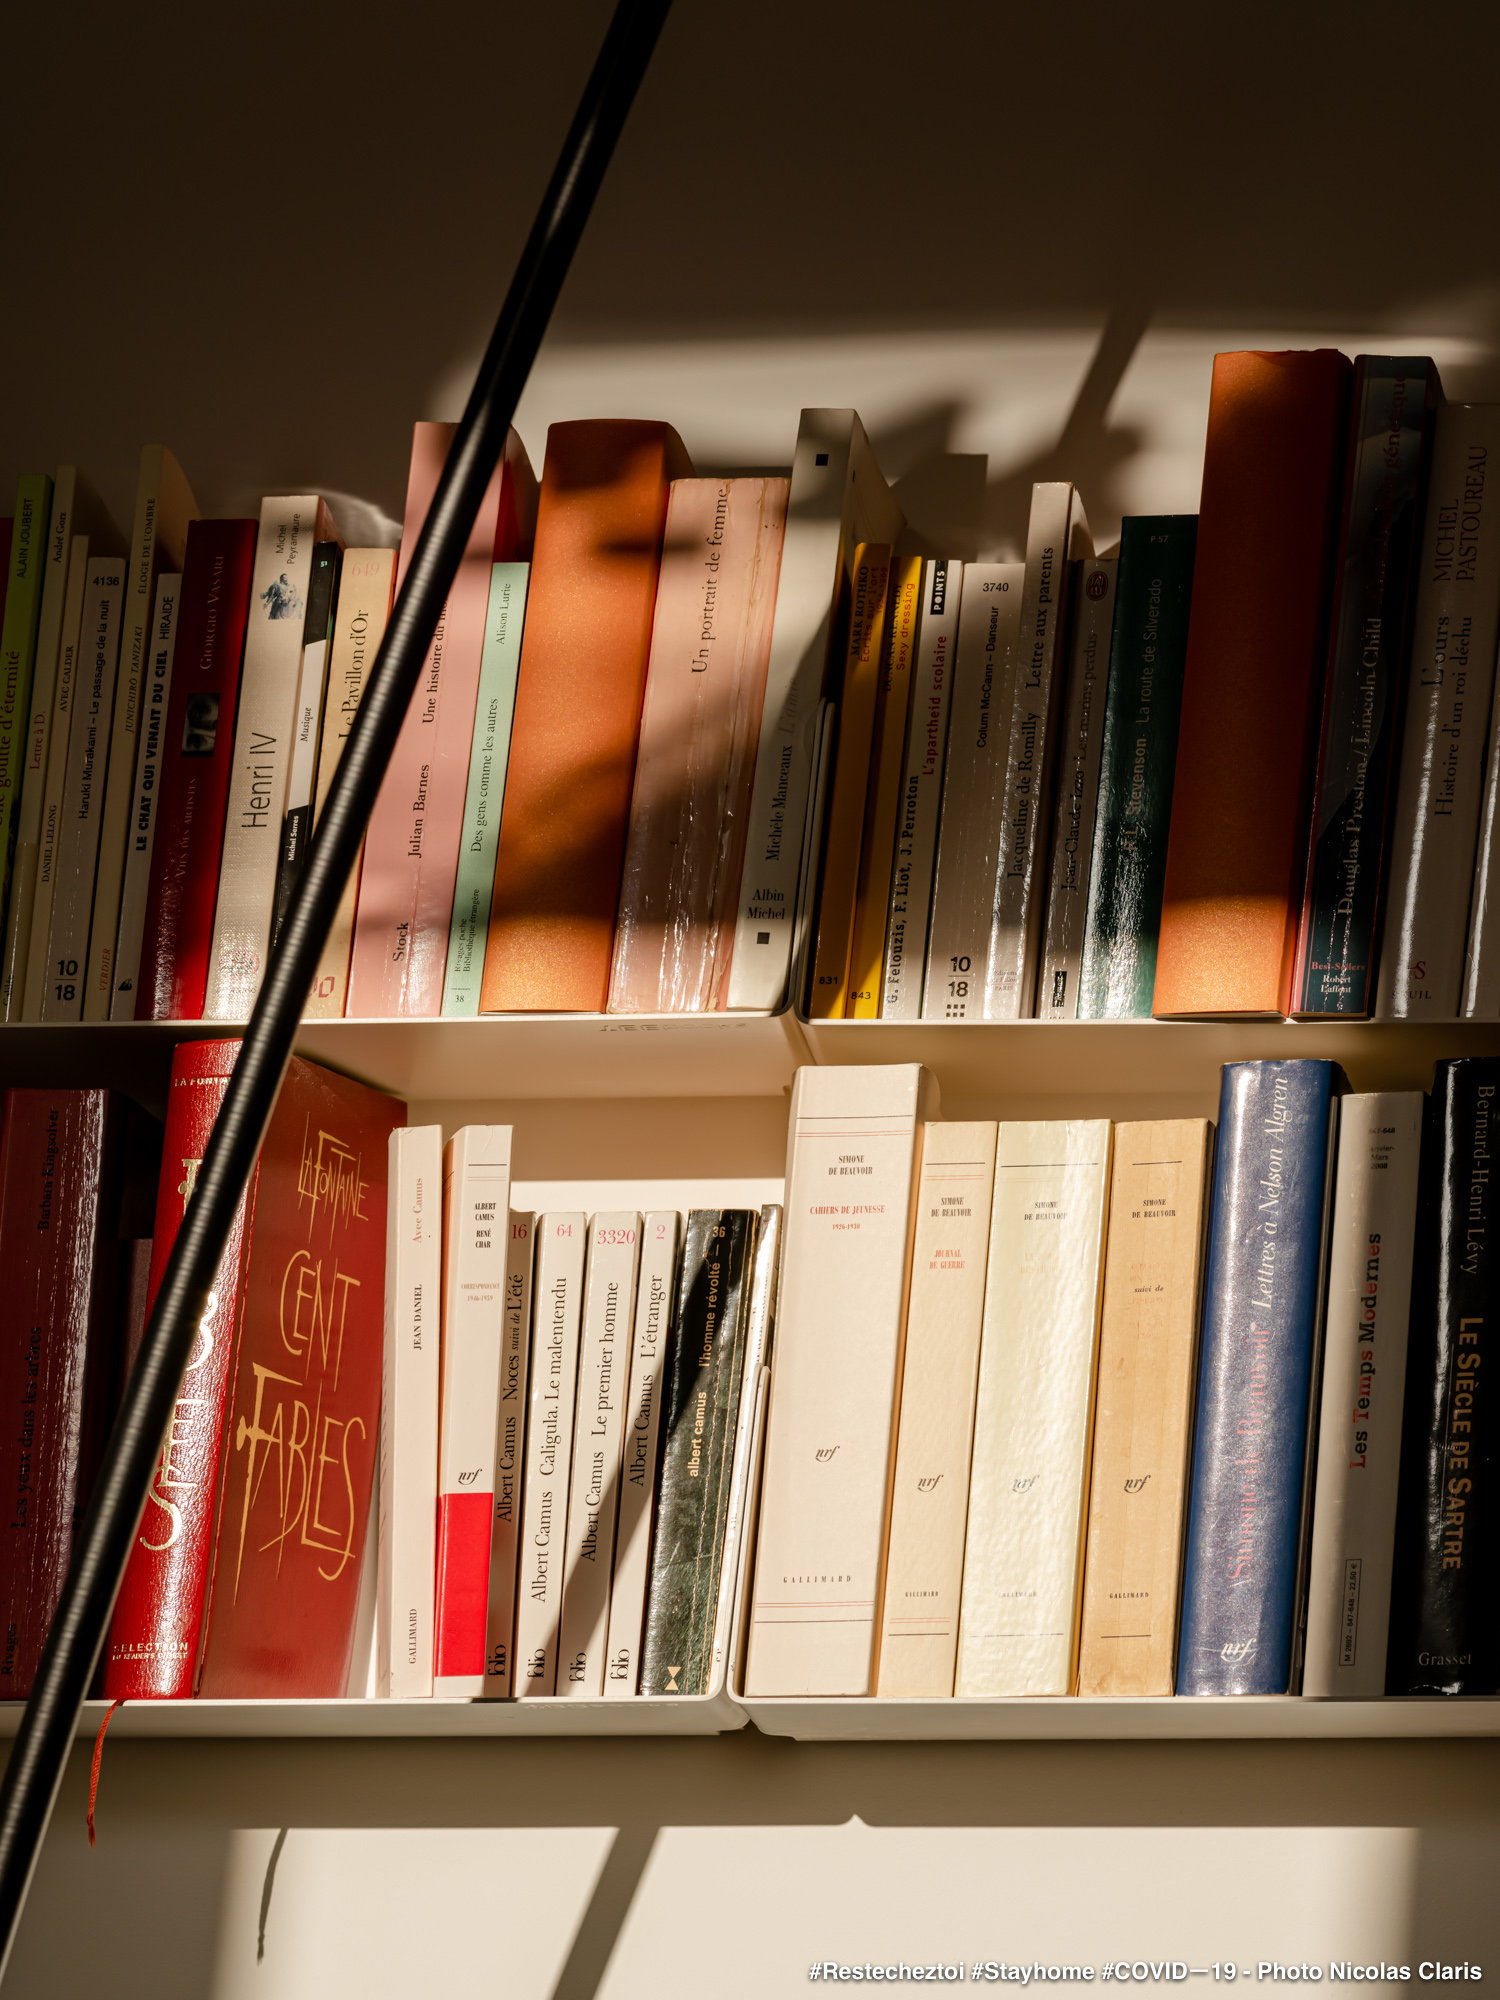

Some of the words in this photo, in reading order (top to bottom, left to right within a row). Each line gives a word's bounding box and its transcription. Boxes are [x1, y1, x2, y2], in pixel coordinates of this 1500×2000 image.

[21, 498, 34, 545] JOUBERT
[56, 512, 66, 534] Gorz
[707, 489, 728, 546] femme
[1456, 446, 1488, 581] PASTOUREAU
[53, 536, 64, 563] André
[276, 524, 287, 554] Michel
[287, 513, 300, 564] Peyramaure
[1433, 499, 1459, 582] MICHEL
[17, 546, 30, 579] ALAIN
[351, 561, 380, 576] 649
[705, 552, 720, 573] de
[1039, 547, 1053, 603] parents
[93, 576, 120, 586] 4136
[499, 583, 511, 609] Lurie
[855, 566, 868, 617] ROTHKO
[933, 571, 945, 610] POINTS
[983, 582, 1009, 592] 3740
[98, 616, 107, 633] la
[100, 600, 110, 614] nuit
[160, 596, 174, 640] HIRAIDE
[702, 579, 718, 641] portrait
[901, 583, 915, 637] dressing
[1035, 608, 1047, 637] aux
[97, 634, 106, 649] de
[434, 625, 444, 641] du
[496, 613, 507, 645] Alison
[851, 621, 862, 656] MARK
[986, 606, 999, 652] Danseur
[1450, 616, 1472, 665] déchu
[155, 650, 168, 678] CIEL
[426, 644, 442, 692] histoire
[692, 648, 709, 674] Un
[897, 643, 908, 670] Sexy
[1025, 641, 1044, 689] Lettre
[1421, 616, 1449, 686] L'ours
[92, 652, 106, 698] passage
[981, 665, 993, 709] McCann
[1453, 672, 1465, 695] roi
[89, 700, 99, 716] Le
[152, 684, 163, 703] DU
[422, 698, 436, 724] Une
[923, 697, 941, 775] L'apartheid
[934, 636, 946, 690] scolaire
[300, 707, 312, 742] Musique
[487, 698, 498, 732] autres
[977, 712, 990, 748] Colum
[1442, 702, 1463, 738] d'un
[146, 708, 161, 759] VENAIT
[249, 732, 277, 755] IV
[482, 736, 493, 752] les
[1018, 712, 1040, 772] Romilly
[84, 727, 97, 780] Murakami
[143, 764, 155, 791] QUI
[413, 764, 430, 811] Barnes
[480, 755, 491, 797] comme
[772, 745, 792, 808] Manceaux
[1016, 777, 1030, 794] de
[1435, 744, 1459, 816] Histoire
[79, 783, 91, 819] Haruki
[138, 796, 151, 830] CHAT
[241, 765, 274, 828] Henri
[477, 800, 487, 827] gens
[46, 805, 57, 844] LELONG
[290, 815, 299, 837] Serres
[408, 819, 424, 858] Julian
[471, 830, 483, 852] Des
[766, 811, 784, 861] Michèle
[1007, 800, 1029, 879] Jacqueline
[136, 836, 147, 851] LE
[288, 838, 296, 861] Michel
[42, 846, 52, 882] DANIEL
[752, 889, 784, 902] Albin
[747, 907, 785, 920] Michel
[393, 922, 408, 962] Stock
[58, 960, 78, 975] 10
[819, 976, 838, 985] 831
[55, 985, 75, 1000] 18
[851, 992, 871, 1000] 843
[1264, 1077, 1293, 1142] Algren
[43, 1108, 60, 1176] Kingsolver
[838, 1155, 865, 1163] SIMONE
[1468, 1085, 1496, 1222] Bernard-Henri
[828, 1167, 838, 1176] DE
[840, 1166, 873, 1175] BEAUVOIR
[1258, 1148, 1284, 1215] Nelson
[38, 1181, 53, 1231] Barbara
[413, 1178, 423, 1213] Camus
[931, 1209, 940, 1217] DE
[941, 1208, 972, 1217] BEAUVOIR
[941, 1197, 964, 1206] SIMONE
[1142, 1198, 1167, 1207] SIMONE
[412, 1216, 422, 1243] Avec
[511, 1224, 527, 1239] 16
[557, 1224, 572, 1237] 64
[1132, 1211, 1141, 1219] DE
[1143, 1209, 1176, 1218] BEAUVOIR
[1257, 1221, 1278, 1234] à
[476, 1228, 491, 1237] RENÉ
[598, 1229, 635, 1245] 3320
[656, 1225, 665, 1239] 2
[712, 1226, 726, 1238] 36
[1460, 1228, 1485, 1275] Lévy
[1251, 1239, 1276, 1309] Lettres
[1358, 1233, 1381, 1343] Modernes
[414, 1284, 422, 1322] DANIEL
[507, 1274, 523, 1311] L'été
[280, 1250, 360, 1391] CENT
[510, 1313, 520, 1325] de
[548, 1277, 566, 1375] malentendu
[599, 1282, 619, 1342] homme
[641, 1275, 666, 1358] L'étranger
[413, 1325, 422, 1350] JEAN
[509, 1325, 519, 1351] suivi
[1459, 1318, 1483, 1345] LE
[502, 1356, 518, 1401] Noces
[545, 1380, 559, 1400] Le
[597, 1348, 613, 1411] premier
[1353, 1351, 1375, 1423] Temps
[1454, 1353, 1481, 1433] SIÈCLE
[634, 1374, 654, 1431] Camus
[500, 1416, 516, 1470] Camus
[539, 1406, 561, 1476] Caligula.
[591, 1415, 607, 1436] Le
[629, 1435, 648, 1486] Albert
[815, 1445, 840, 1463] nrf
[1349, 1430, 1368, 1469] Les
[1450, 1442, 1469, 1470] DE
[233, 1362, 366, 1606] FABLES
[585, 1451, 605, 1506] Camus
[1124, 1474, 1151, 1493] nrf
[497, 1475, 513, 1523] Albert
[534, 1491, 553, 1547] Camus
[581, 1511, 600, 1562] Albert
[1442, 1478, 1472, 1569] SARTRE
[532, 1550, 548, 1602] Albert
[783, 1575, 852, 1583] GALLIMARD
[409, 1609, 417, 1664] GALLIMARD
[1418, 1652, 1472, 1666] Grasset
